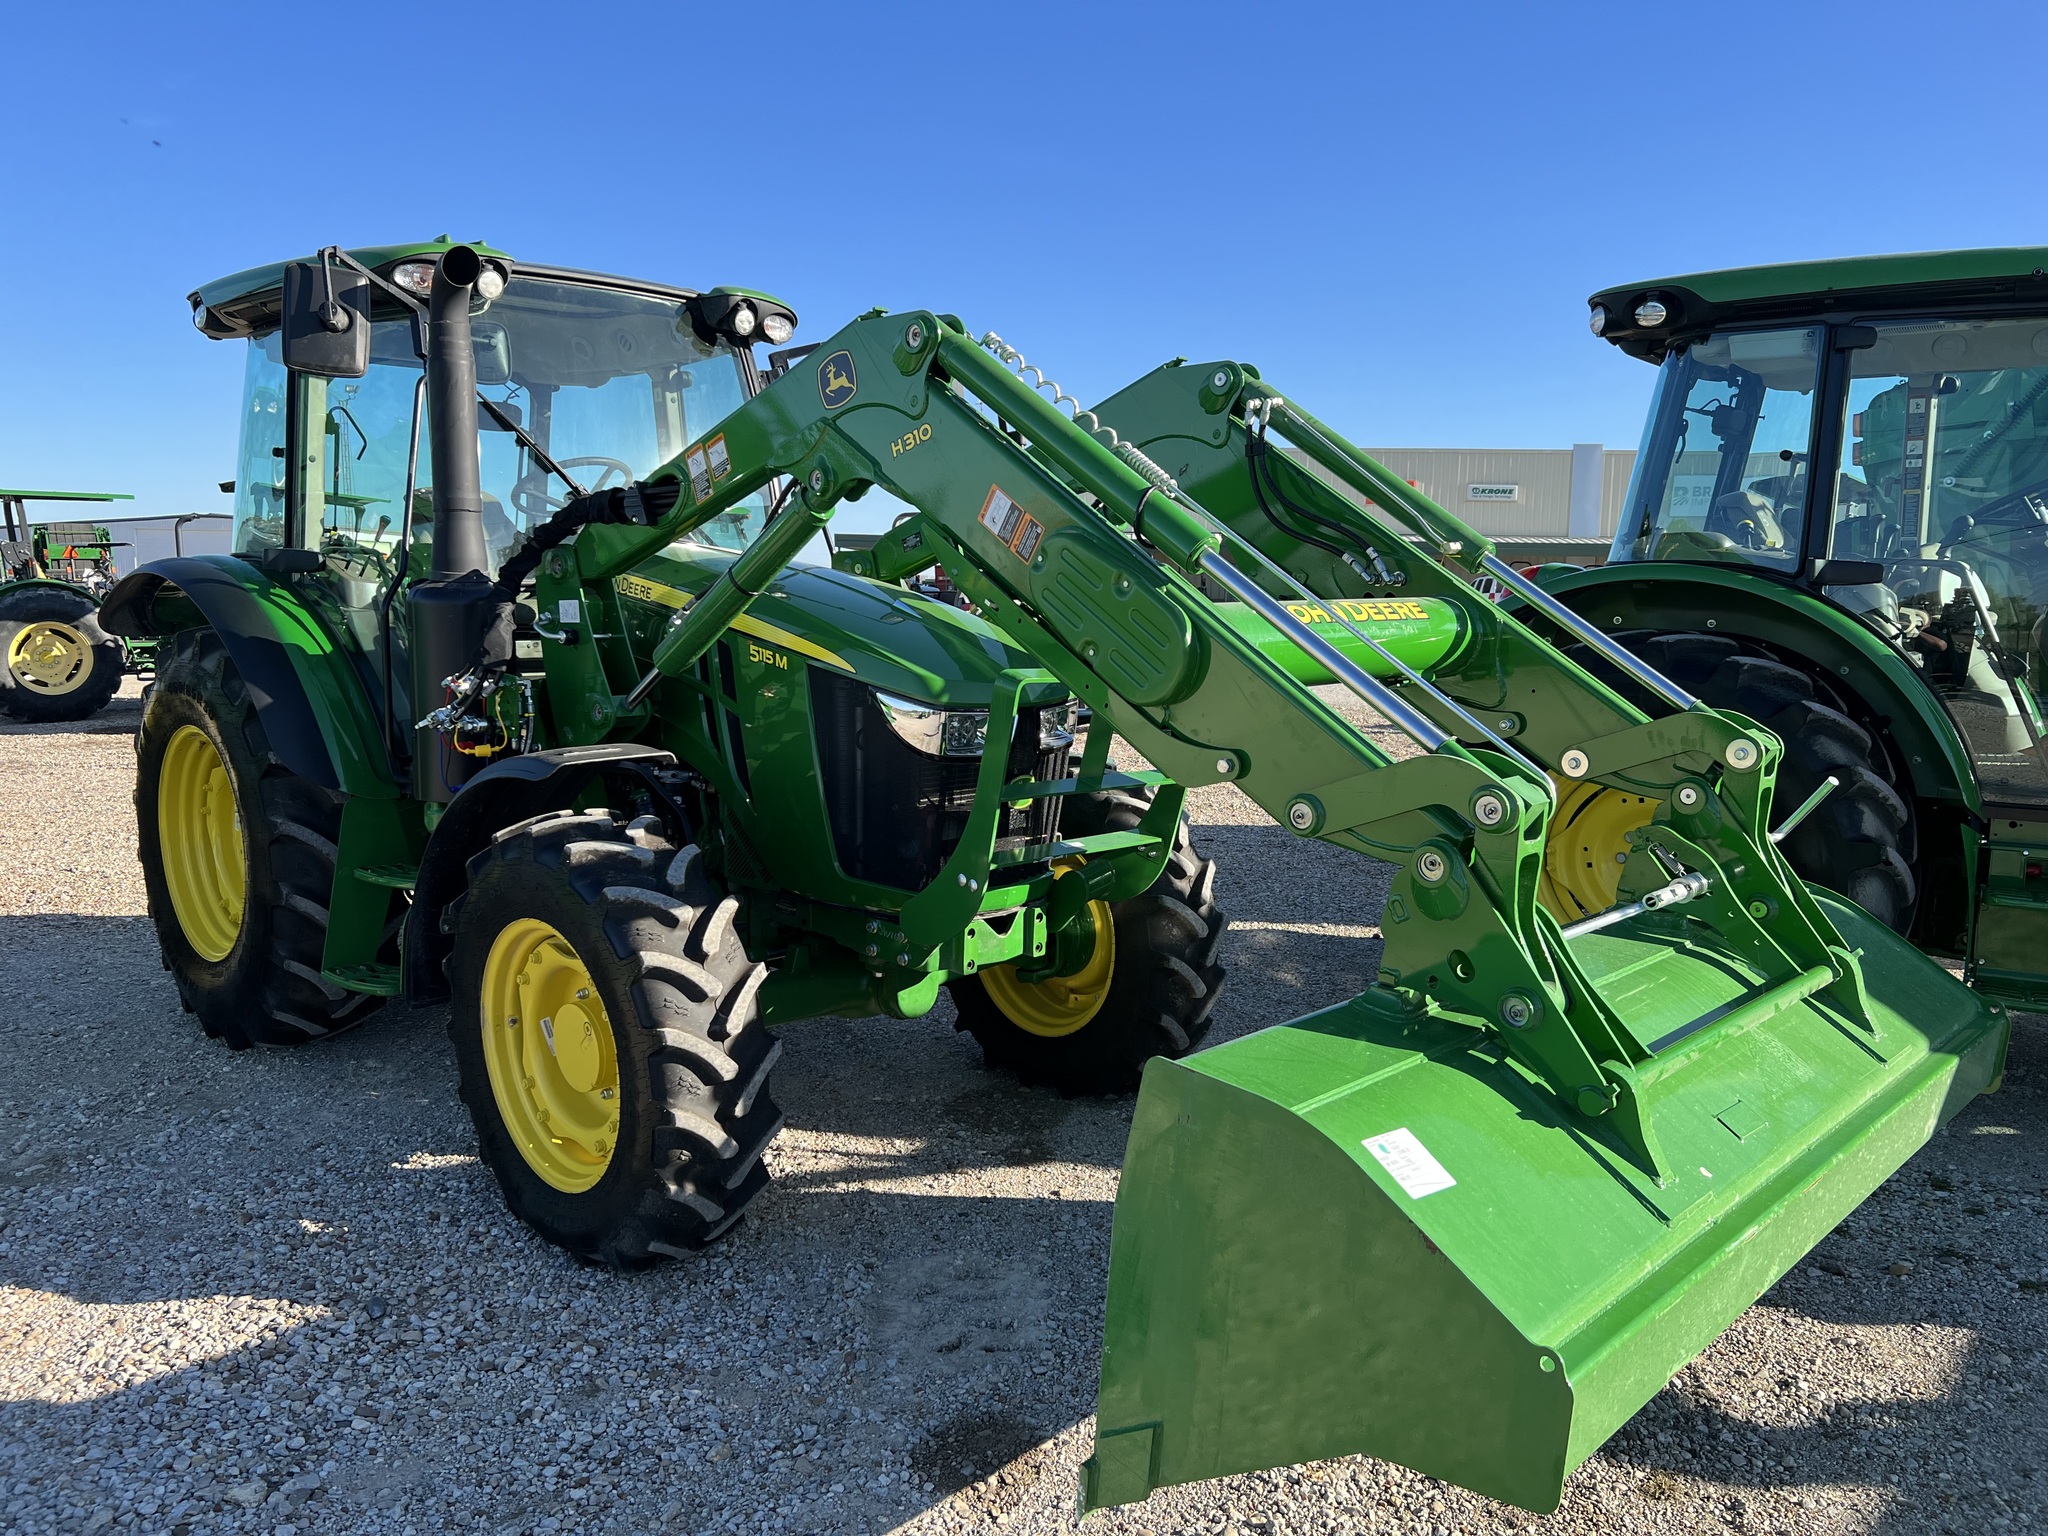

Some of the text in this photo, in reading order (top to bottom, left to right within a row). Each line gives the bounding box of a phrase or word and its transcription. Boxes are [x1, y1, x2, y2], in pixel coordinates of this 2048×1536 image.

[621, 577, 653, 600] DEERE
[1286, 601, 1430, 624] OH DEERE
[749, 644, 788, 671] 5115 M
